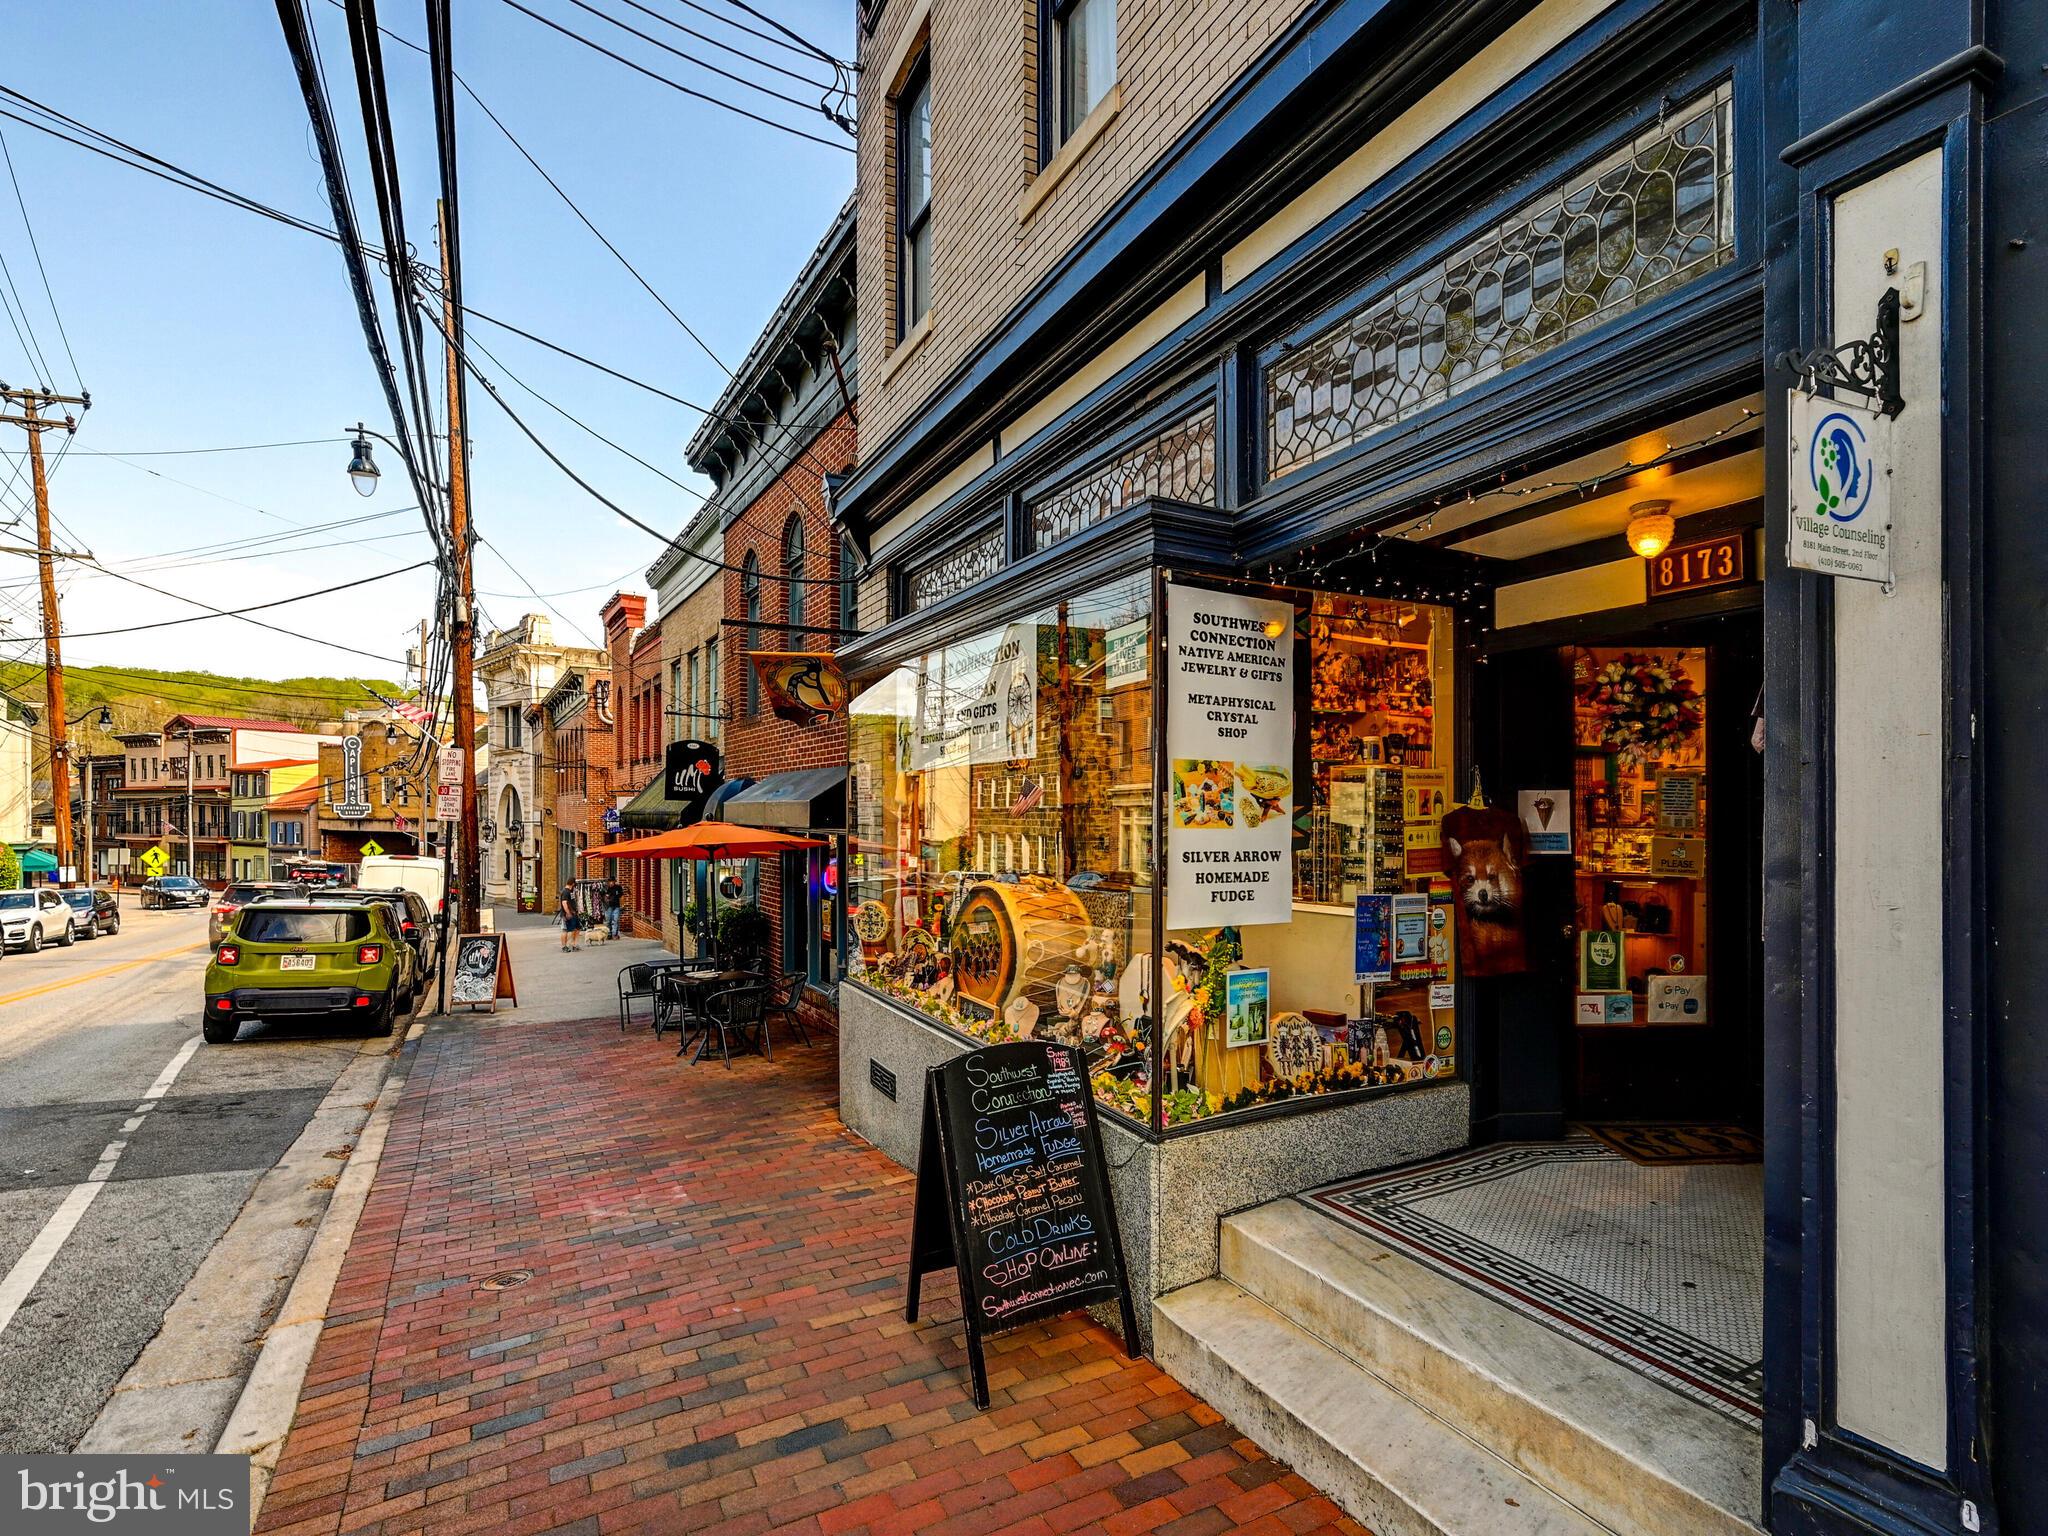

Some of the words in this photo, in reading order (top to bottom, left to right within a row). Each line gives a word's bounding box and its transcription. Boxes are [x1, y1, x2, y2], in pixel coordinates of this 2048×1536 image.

[1796, 516, 1829, 538] Village
[1832, 524, 1885, 549] Counseling
[1803, 540, 1816, 550] 8181
[1818, 543, 1831, 552] Main
[1833, 546, 1851, 557] Street,
[1852, 549, 1862, 557] 2nd
[1864, 551, 1878, 561] Floor
[1661, 545, 1733, 586] 8173
[1818, 556, 1833, 568] (410)
[1193, 612, 1271, 633] SOUTHWES
[1113, 633, 1138, 651] BLACK
[1190, 629, 1276, 651] CONNECTION
[1115, 647, 1136, 663] LIVES
[1179, 645, 1224, 660] NATIVE
[1227, 651, 1286, 668] AMERICAN
[1112, 658, 1141, 677] MATTER
[1181, 662, 1236, 677] JEWELRY
[1240, 668, 1248, 678] &
[1251, 669, 1282, 682] GIFTS
[973, 702, 997, 719] GIFTS
[1188, 693, 1276, 711] METAPHYSICAL
[1207, 711, 1258, 724] CRYSTAL
[921, 732, 944, 745] HISTORIC
[972, 723, 989, 736] CITY,
[989, 721, 999, 733] MD
[1218, 727, 1247, 738] SHOP
[442, 759, 461, 767] STOPPING
[447, 751, 457, 759] NO
[347, 739, 357, 805] CAPLAN'S
[1182, 850, 1231, 863] SILVER
[1233, 850, 1282, 862] ARROW
[1661, 858, 1695, 868] PLEASE
[1195, 871, 1270, 884] HOMEMADE
[1211, 890, 1255, 902] FUDGE
[1429, 966, 1447, 979] LVE
[1664, 985, 1672, 994] G
[1674, 985, 1691, 996] Pay
[1665, 1002, 1679, 1011] Pay
[965, 1054, 1038, 1087] Southwest
[1053, 1058, 1071, 1069] 1989
[971, 1085, 1053, 1112] Connection
[976, 1143, 1036, 1173] Homemade
[1013, 1168, 1029, 1182] Sea
[1026, 1165, 1046, 1179] Salt
[1047, 1155, 1083, 1173] Caramel
[1047, 1176, 1078, 1191] Butter
[1016, 1198, 1051, 1216] Caramel
[988, 1230, 1035, 1254] COLD
[1034, 1213, 1092, 1240] DRINKS
